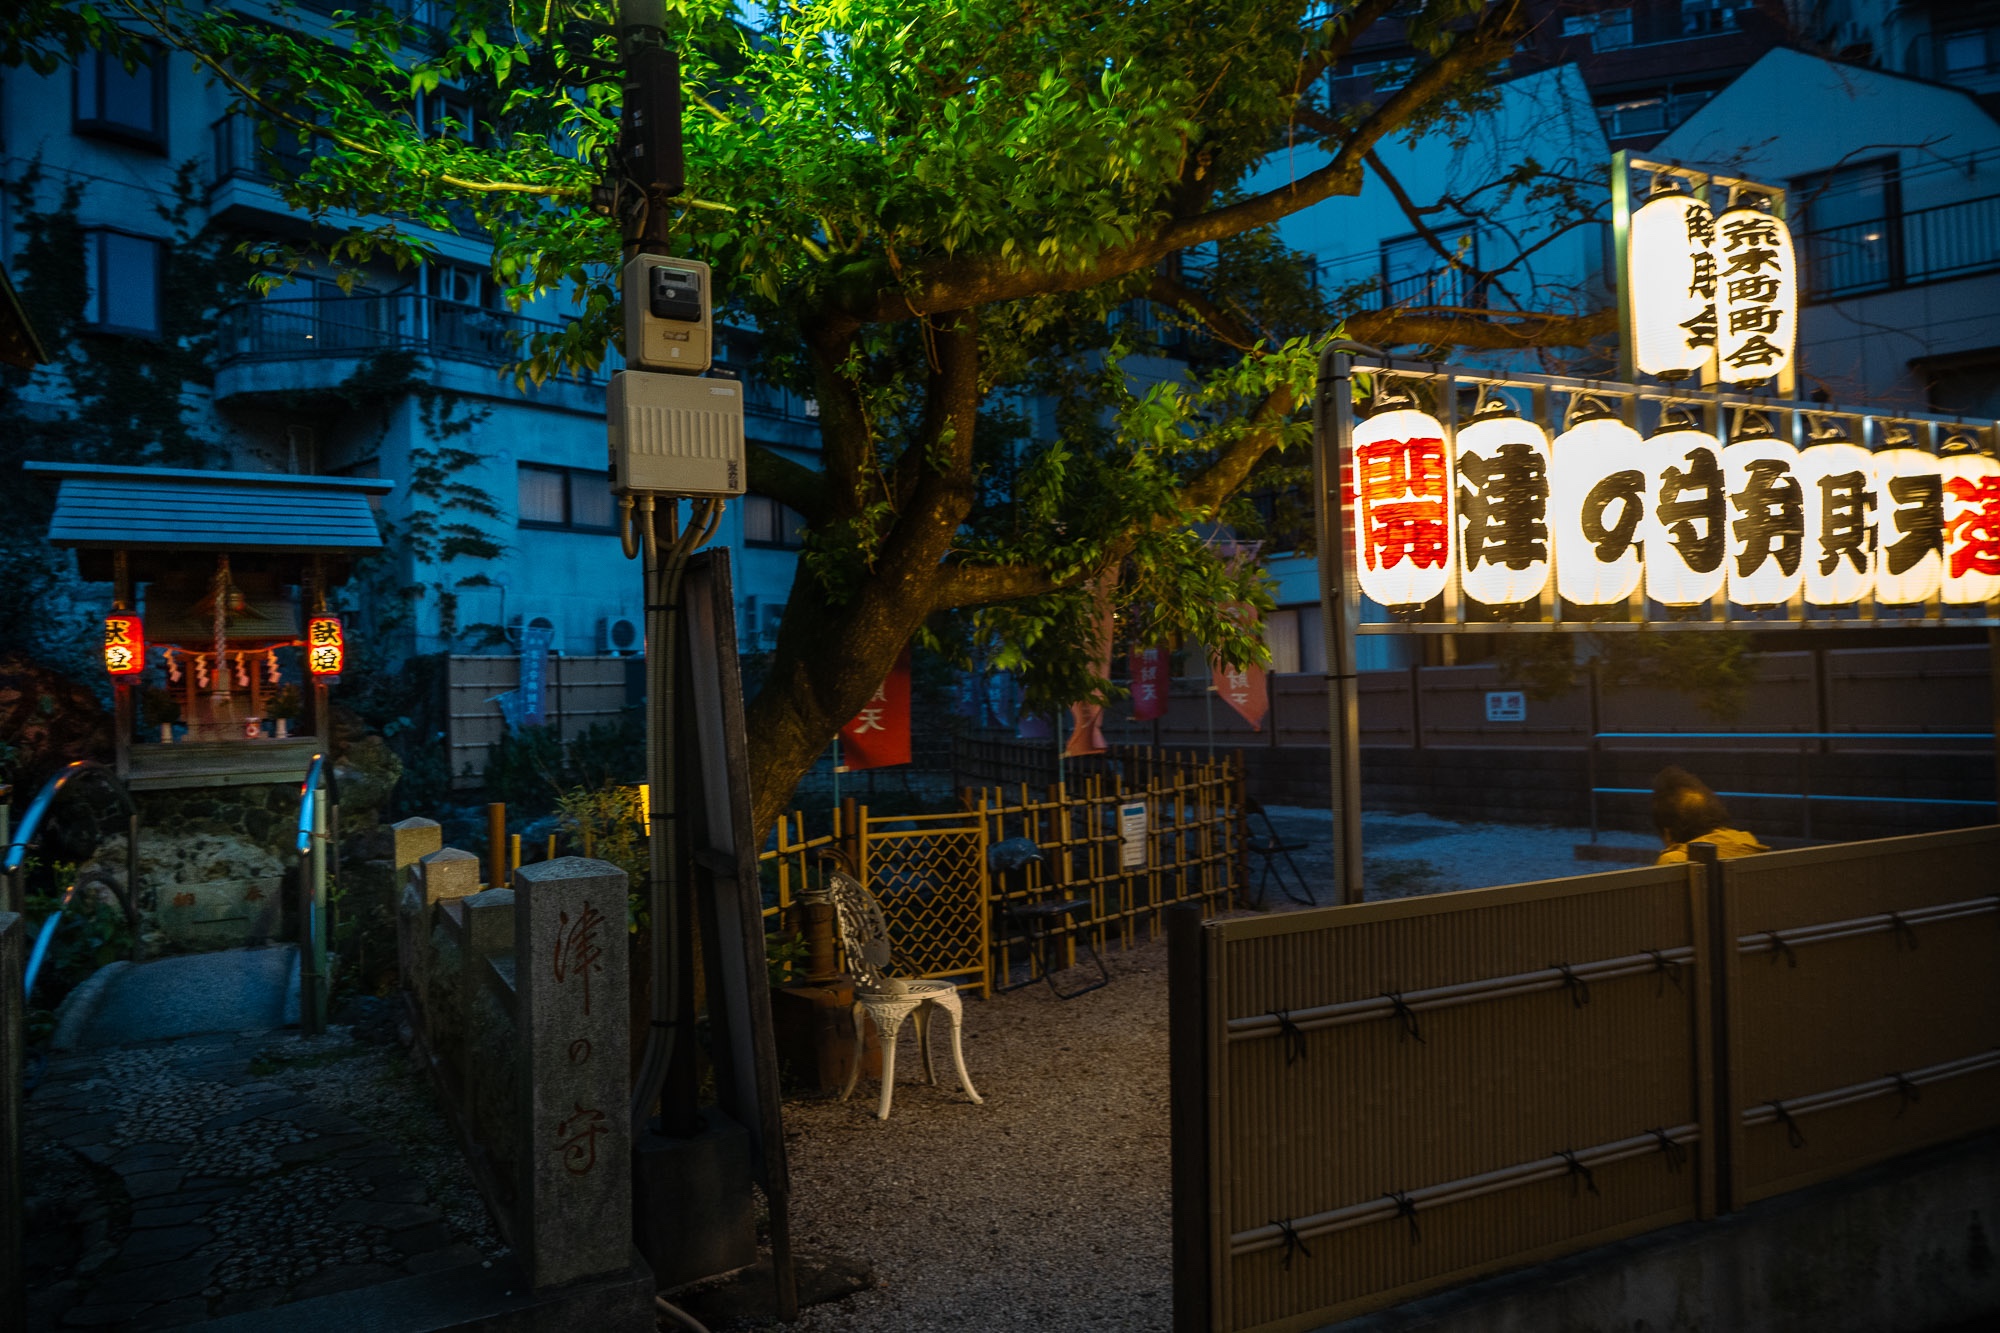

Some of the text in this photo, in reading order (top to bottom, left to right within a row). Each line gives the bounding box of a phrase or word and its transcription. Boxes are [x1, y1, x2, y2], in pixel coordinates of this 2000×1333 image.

[1718, 218, 1784, 369] 荒木町町会
[553, 900, 609, 1177] 津の守
